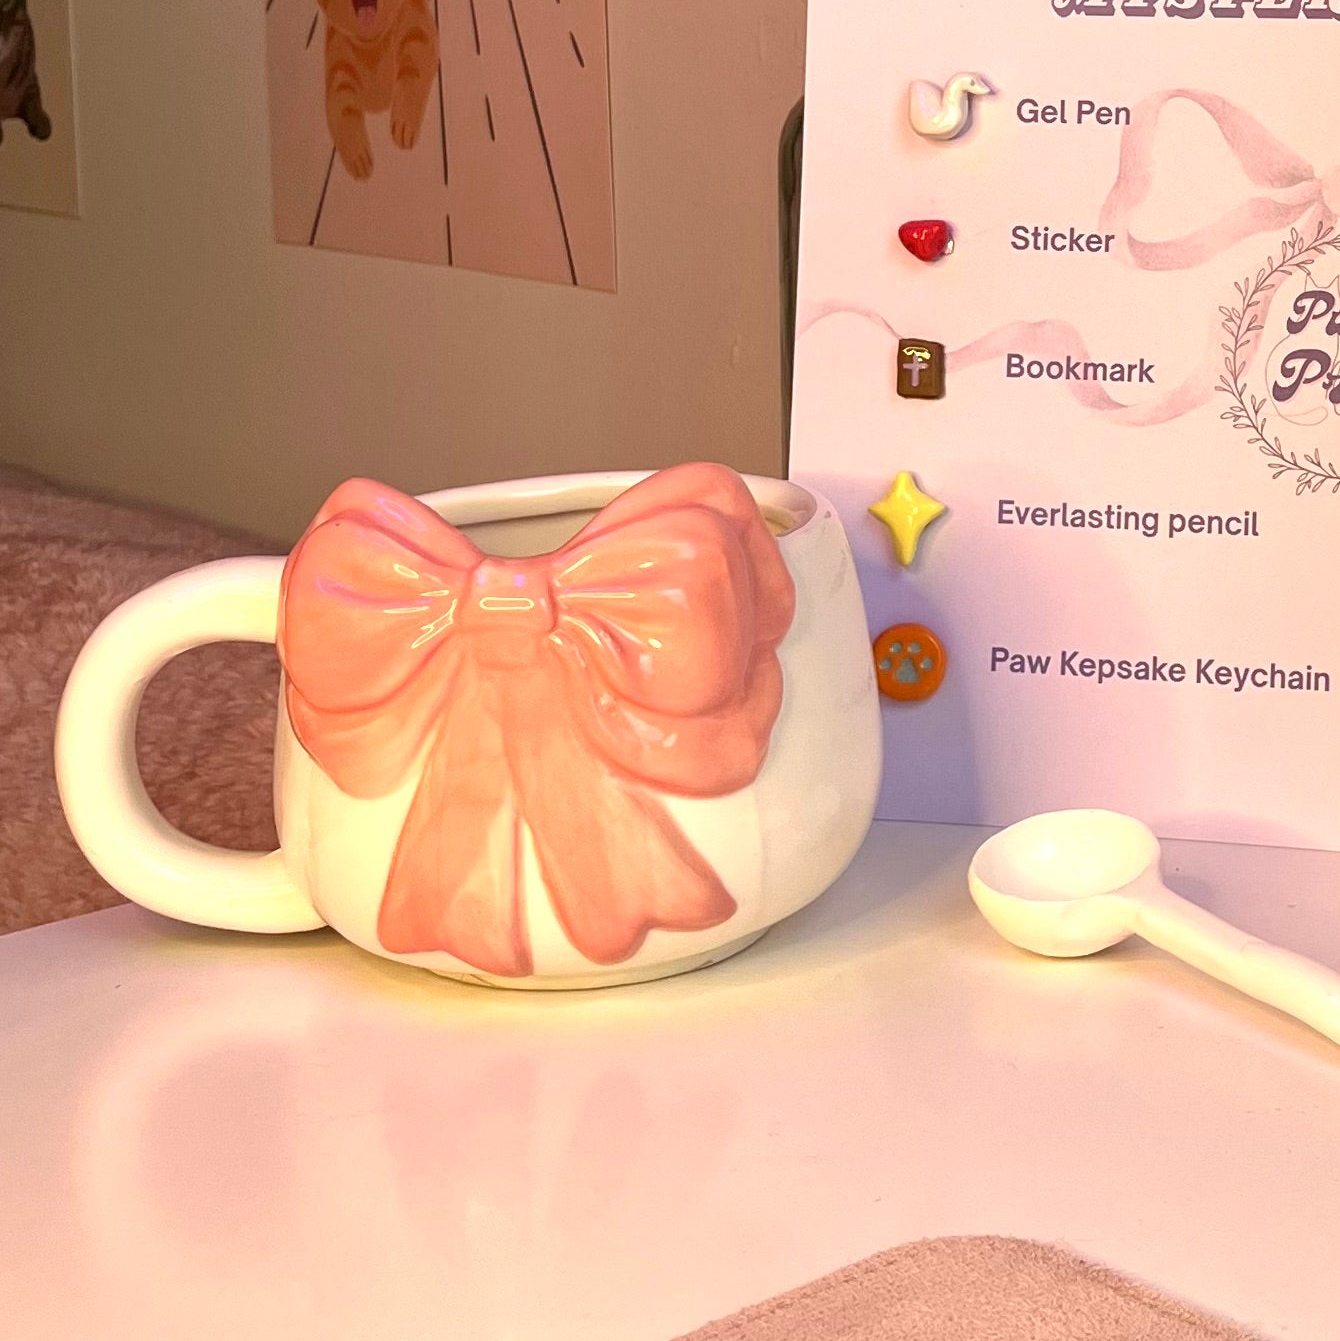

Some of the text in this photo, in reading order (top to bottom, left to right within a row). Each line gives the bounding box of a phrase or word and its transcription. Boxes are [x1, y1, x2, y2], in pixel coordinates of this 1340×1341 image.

[1016, 98, 1131, 126] Gel Pen
[1010, 225, 1116, 253] Sticker
[1006, 352, 1155, 384] Bookmark
[997, 499, 1260, 539] Everlasting pencil
[990, 646, 1330, 693] Paw Kepsake Keychain
